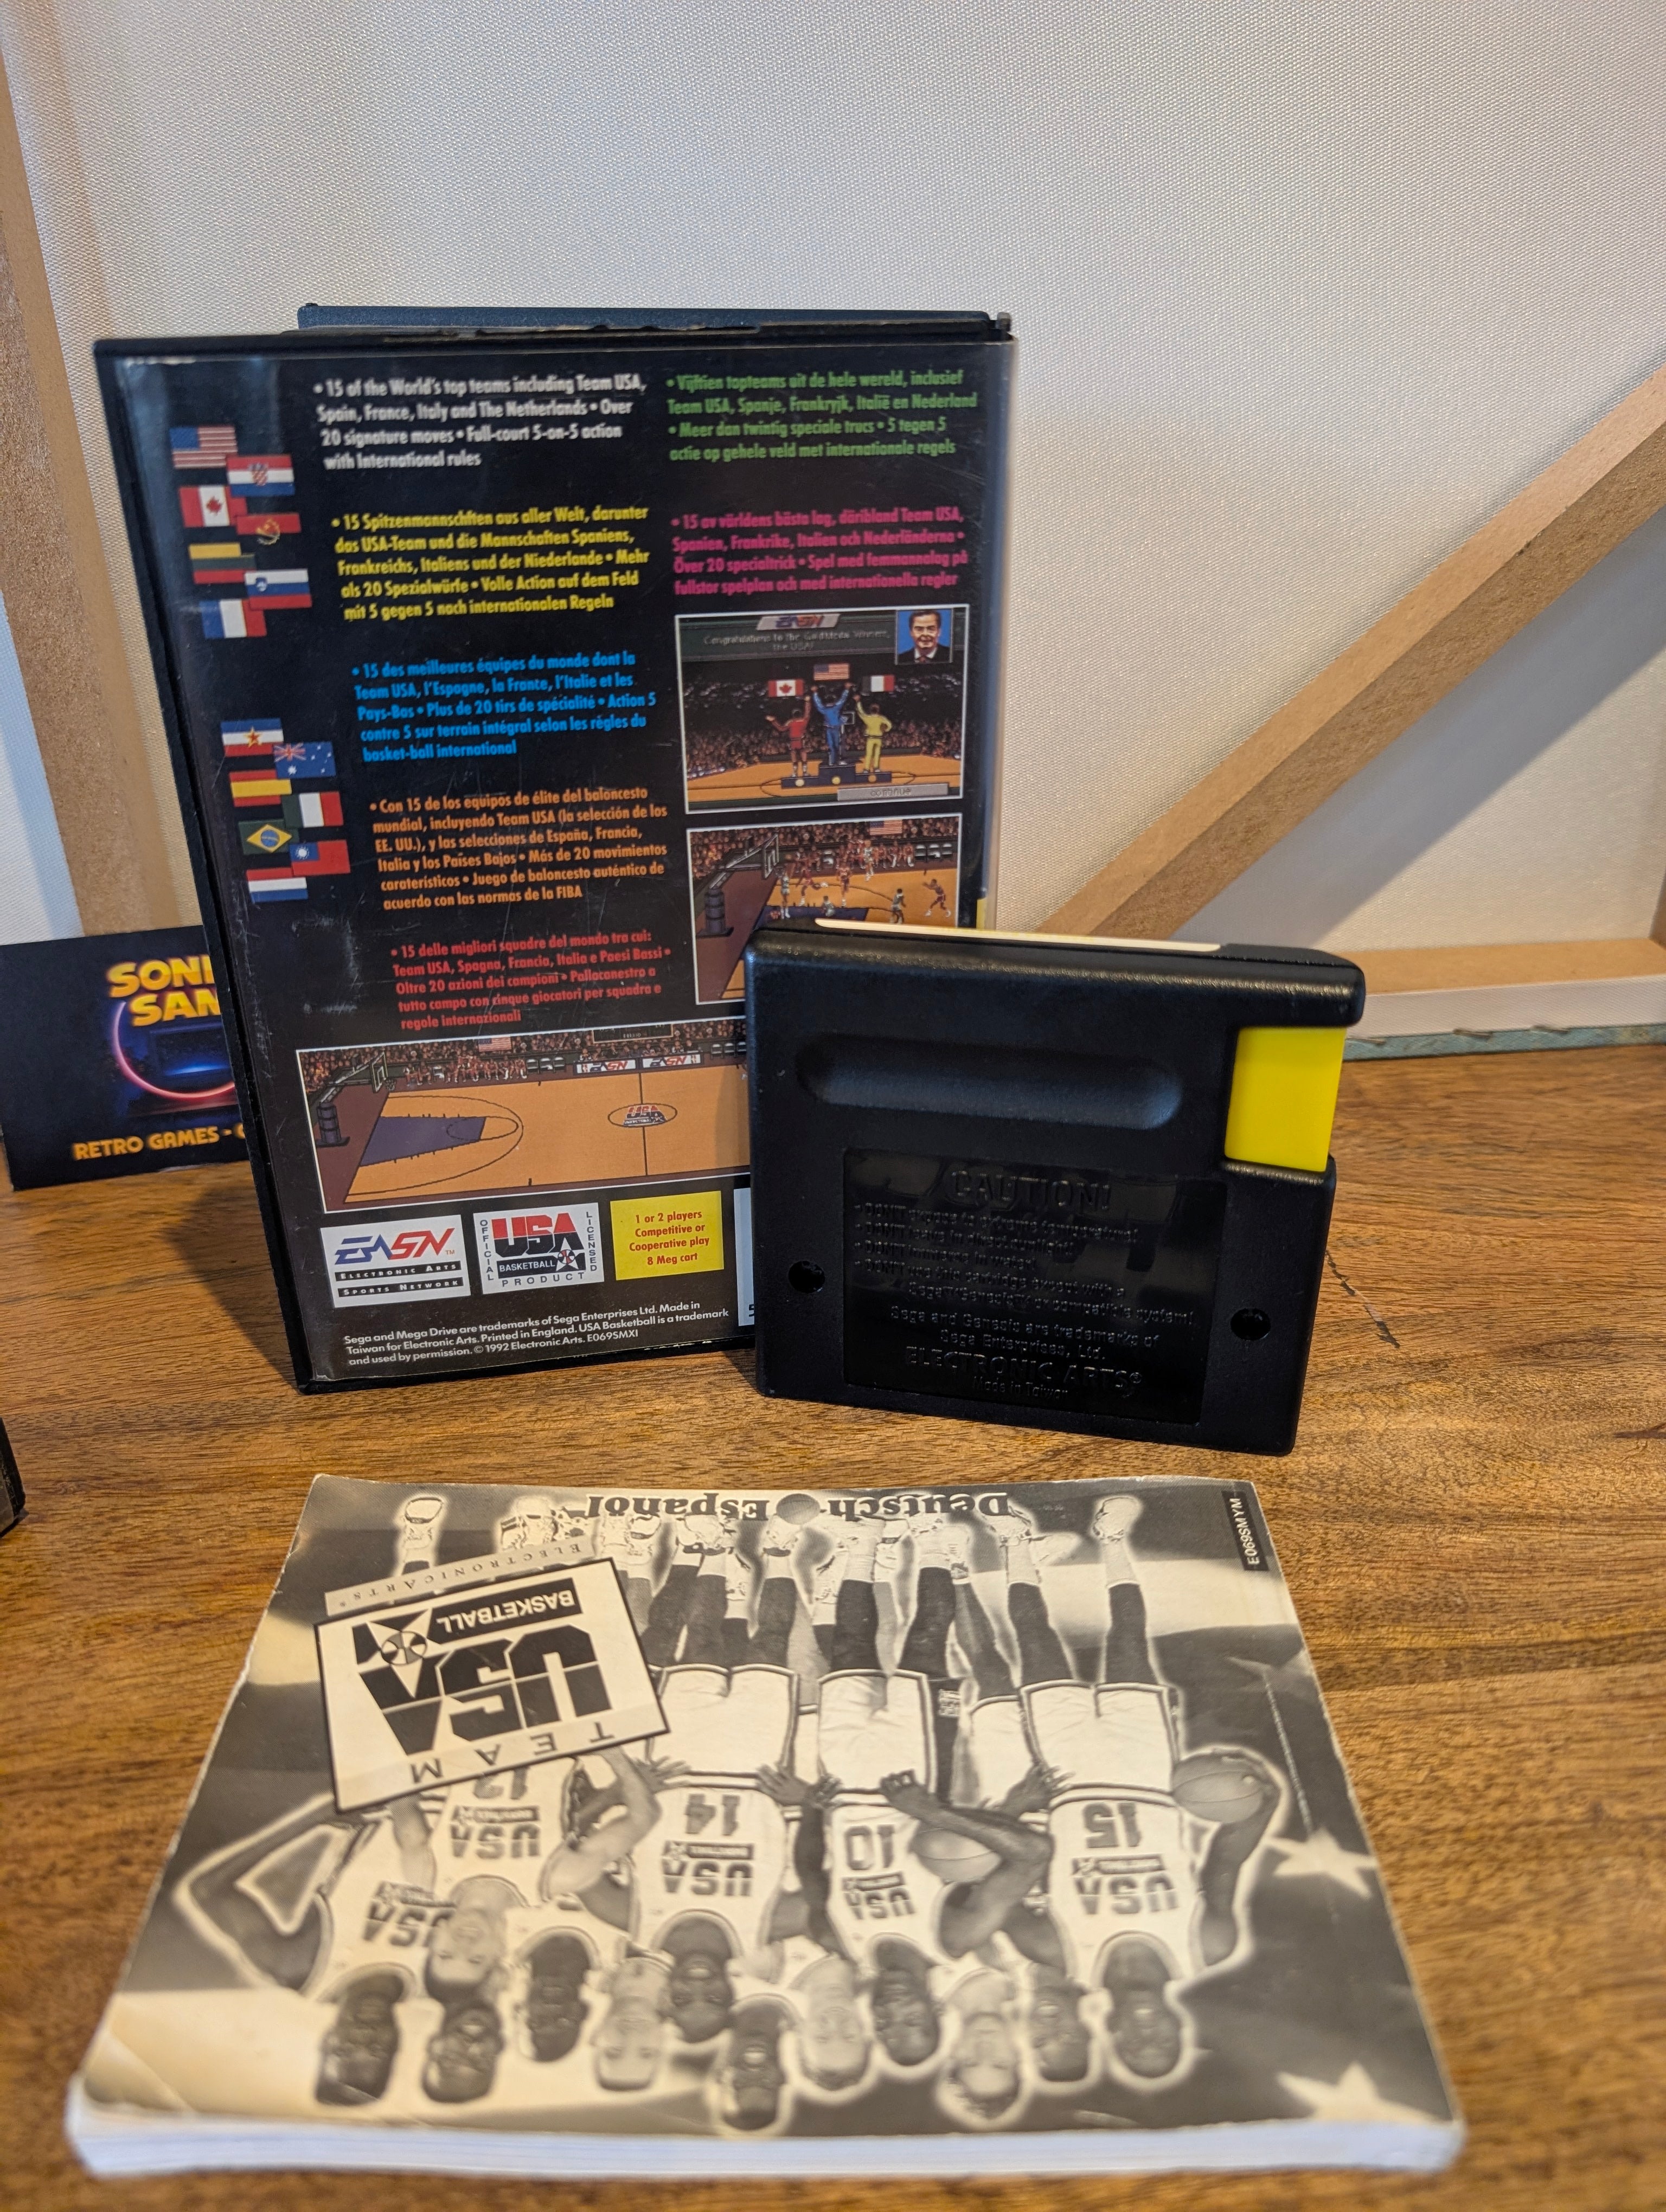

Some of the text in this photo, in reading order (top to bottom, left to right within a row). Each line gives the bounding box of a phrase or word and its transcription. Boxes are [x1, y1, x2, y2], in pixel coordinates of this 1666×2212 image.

[325, 373, 646, 397] 15 of the World's top teams including Team USA,
[319, 422, 622, 448] 20 signature moves Full-court 5-on-5 action
[323, 448, 481, 470] with International rules
[343, 593, 614, 621] mit 5 gegen 5 nach internationalen Regeln
[362, 650, 636, 678] 15 des meilleures équipes du monde dont la
[379, 786, 648, 813] Con 15 de los equipos de élite del baloncesto
[383, 884, 582, 910] acuerdo con las normas de la FIBA
[401, 929, 651, 958] 15 delle migliori squadre del mondo tra cui:
[73, 1136, 144, 1161] RETRO
[148, 1126, 219, 1151] GAMES
[952, 1171, 1111, 1211] CAUTION!
[635, 1214, 639, 1223] 1
[657, 1212, 664, 1221] 2
[667, 1211, 702, 1223] players
[635, 1224, 692, 1237] Competitive
[480, 1219, 494, 1281] OFFICIAL
[491, 1212, 584, 1258] USA
[586, 1211, 597, 1271] LICENSED
[629, 1237, 709, 1251] Cooperative play
[499, 1259, 556, 1272] BASKETBALL
[646, 1252, 697, 1265] 8 Meg cart
[502, 1272, 585, 1287] PRODUCT
[343, 1335, 371, 1345] Sega
[373, 1330, 394, 1341] and
[395, 1330, 428, 1340] Mega
[429, 1327, 458, 1336] Drive
[478, 1317, 540, 1332] trademarks
[541, 1315, 552, 1325] of
[553, 1315, 579, 1324] Sega
[581, 1309, 639, 1322] Enterprises
[639, 1304, 659, 1319] Ltd.
[658, 1301, 689, 1318] Made
[690, 1301, 700, 1315] in
[345, 1345, 385, 1354] Taiwan
[386, 1342, 402, 1351] for
[402, 1336, 454, 1349] Electronic
[455, 1336, 479, 1345] Arts.
[480, 1330, 518, 1342] Printed
[520, 1329, 530, 1338] in
[531, 1324, 577, 1338] England.
[578, 1322, 601, 1332] USA
[602, 1315, 656, 1329] Basketball
[657, 1315, 665, 1324] is
[675, 1308, 728, 1321] trademark
[891, 1306, 1159, 1348] Sega and Genesis are trademarks of
[940, 1329, 975, 1347] Sega
[348, 1355, 370, 1365] and
[371, 1352, 396, 1363] used
[397, 1352, 411, 1362] by
[412, 1347, 472, 1361] permission.
[484, 1342, 509, 1352] 1992
[510, 1338, 561, 1350] Electronic
[561, 1336, 585, 1345] Arts.
[906, 1346, 1053, 1380] ELECTRONIC
[828, 1493, 1012, 1521] Deutsch
[436, 1588, 575, 1633] BASKETBALL
[358, 1625, 612, 1756] USA
[411, 1722, 615, 1783] TEAM
[685, 1794, 741, 1836] 14
[1083, 1802, 1142, 1849] 15
[450, 1823, 541, 1859] USA
[844, 1825, 896, 1871] 10
[661, 1861, 754, 1897] USA
[842, 1887, 917, 1920] USA
[1072, 1877, 1180, 1915] USA
